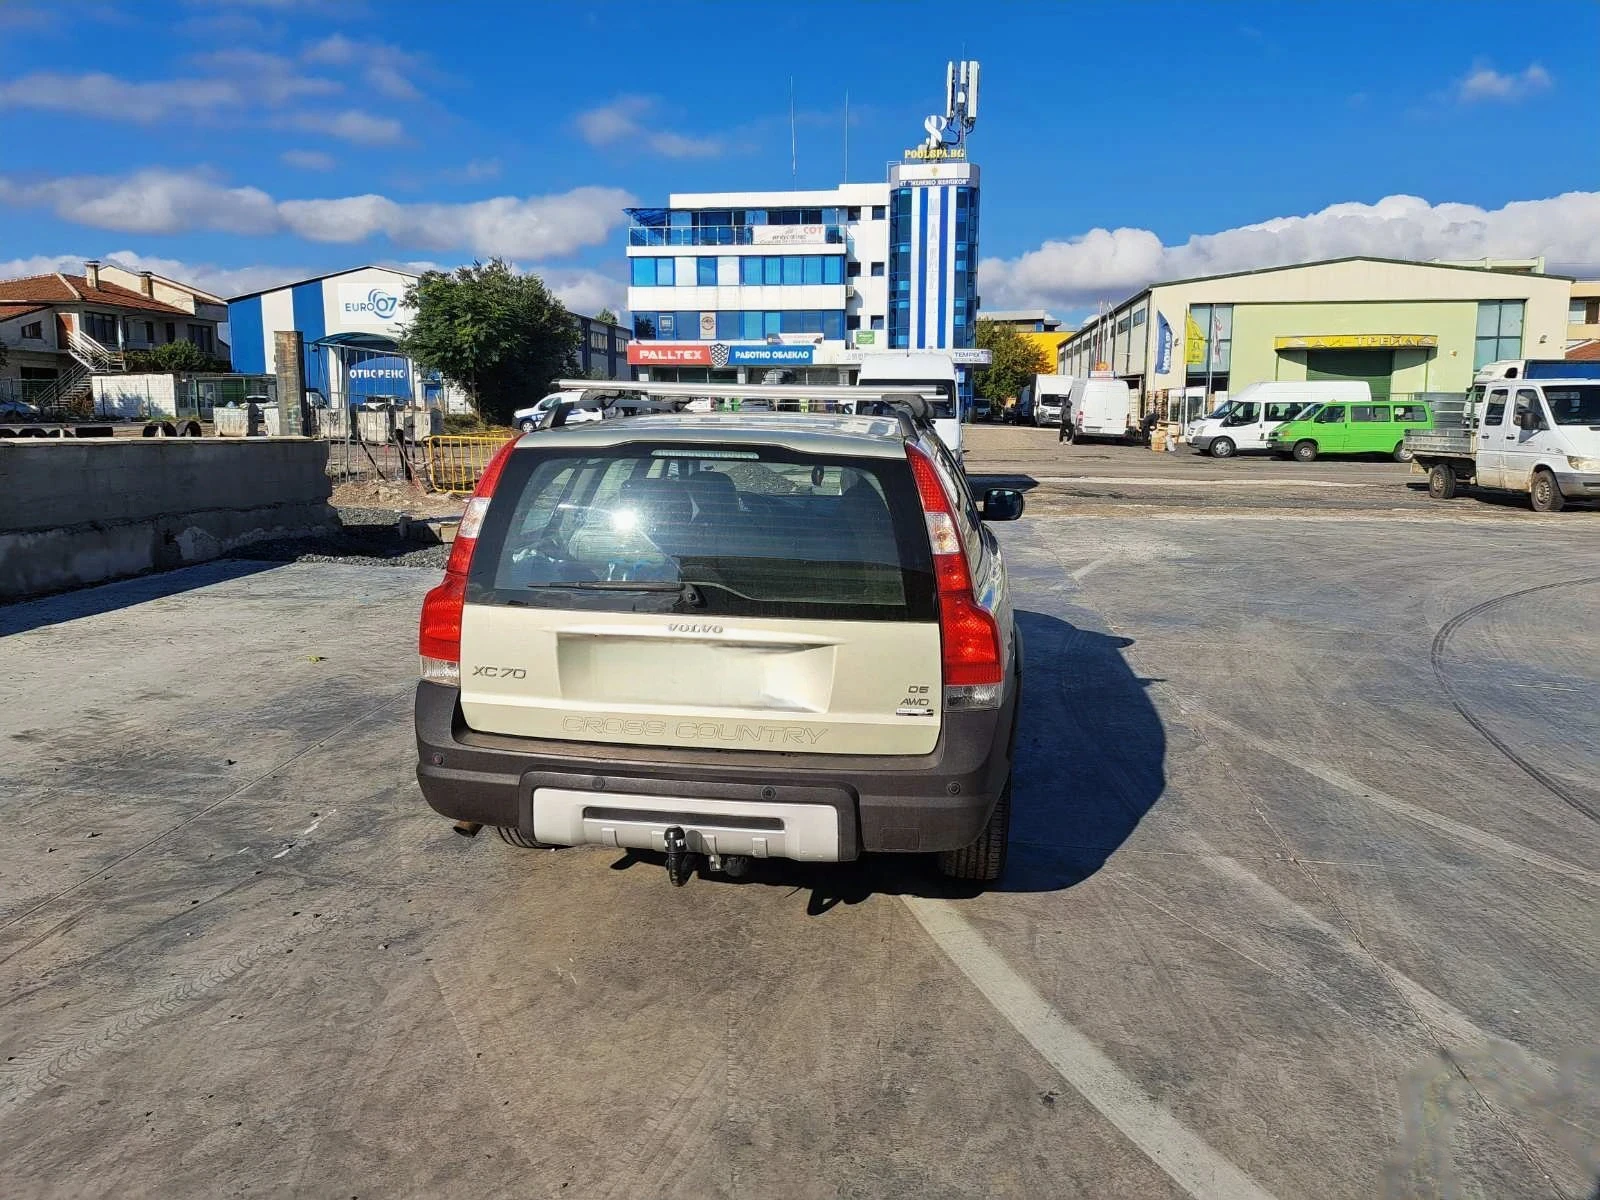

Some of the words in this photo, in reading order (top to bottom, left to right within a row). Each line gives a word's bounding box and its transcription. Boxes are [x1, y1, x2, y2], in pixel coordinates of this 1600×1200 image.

[904, 149, 965, 159] POOLSPA.BG
[345, 302, 375, 312] EURO
[639, 350, 702, 360] PALLTEX
[735, 350, 771, 359] РАБОТНО
[772, 350, 809, 359] ОБЛЕКЛО
[668, 623, 724, 635] VOLVO
[908, 685, 930, 694] D5
[900, 698, 930, 706] AWD
[562, 715, 667, 737] CROSS
[675, 721, 829, 744] COUNTRY
